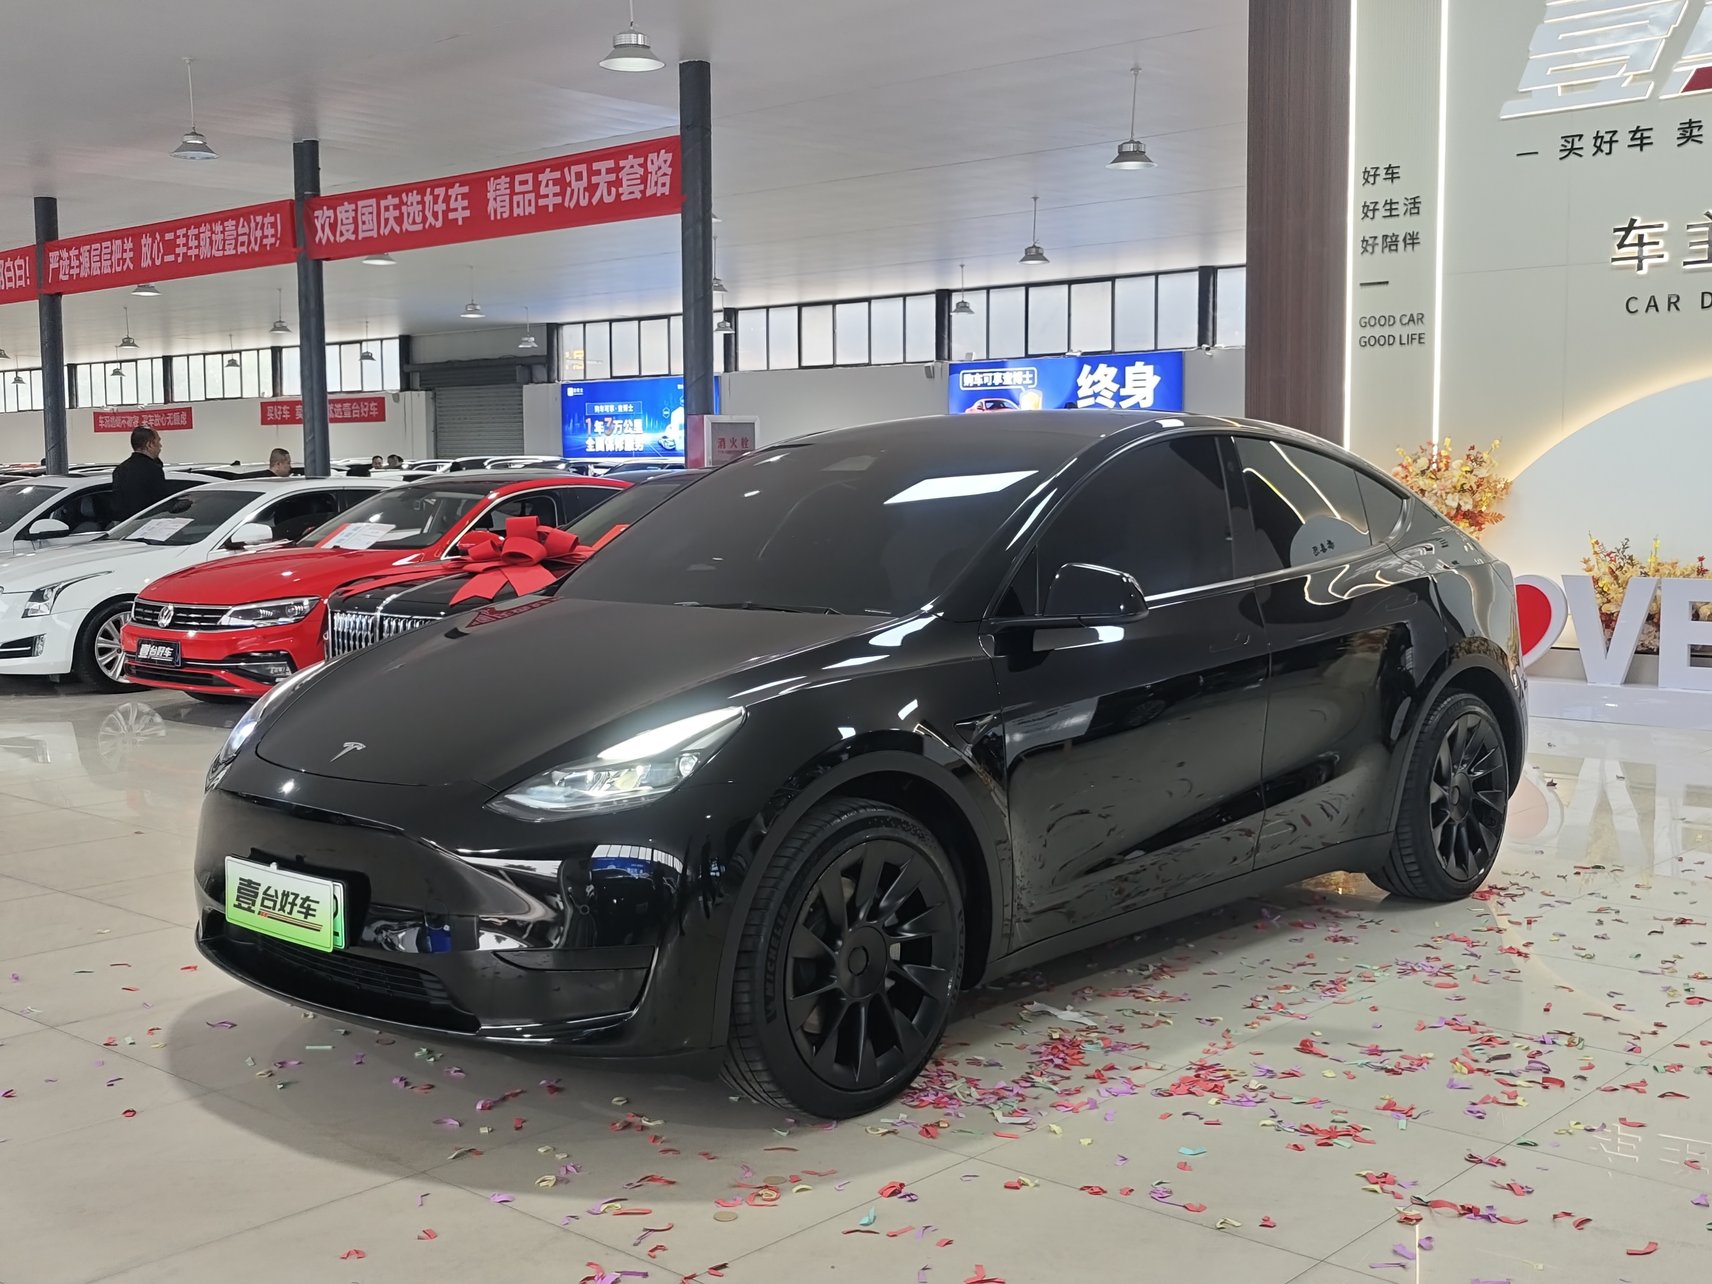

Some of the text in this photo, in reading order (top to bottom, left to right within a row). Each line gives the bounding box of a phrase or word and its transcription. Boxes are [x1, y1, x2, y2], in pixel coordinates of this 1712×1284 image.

[1559, 118, 1704, 160] 买好车 卖
[1362, 163, 1401, 186] 好车
[314, 149, 673, 245] 欢度国庆选好车 精品车况无套路
[1361, 196, 1422, 220] 好生活
[1360, 230, 1421, 255] 好陪伴
[48, 238, 134, 283] 严选车源层层把关
[1625, 293, 1681, 314] CAR
[1359, 312, 1425, 328] GOOD CAR
[1359, 332, 1426, 348] GOOD LIFE
[1076, 361, 1161, 409] 终身
[267, 405, 291, 420] 买好车
[233, 877, 320, 920] 壹台好车
